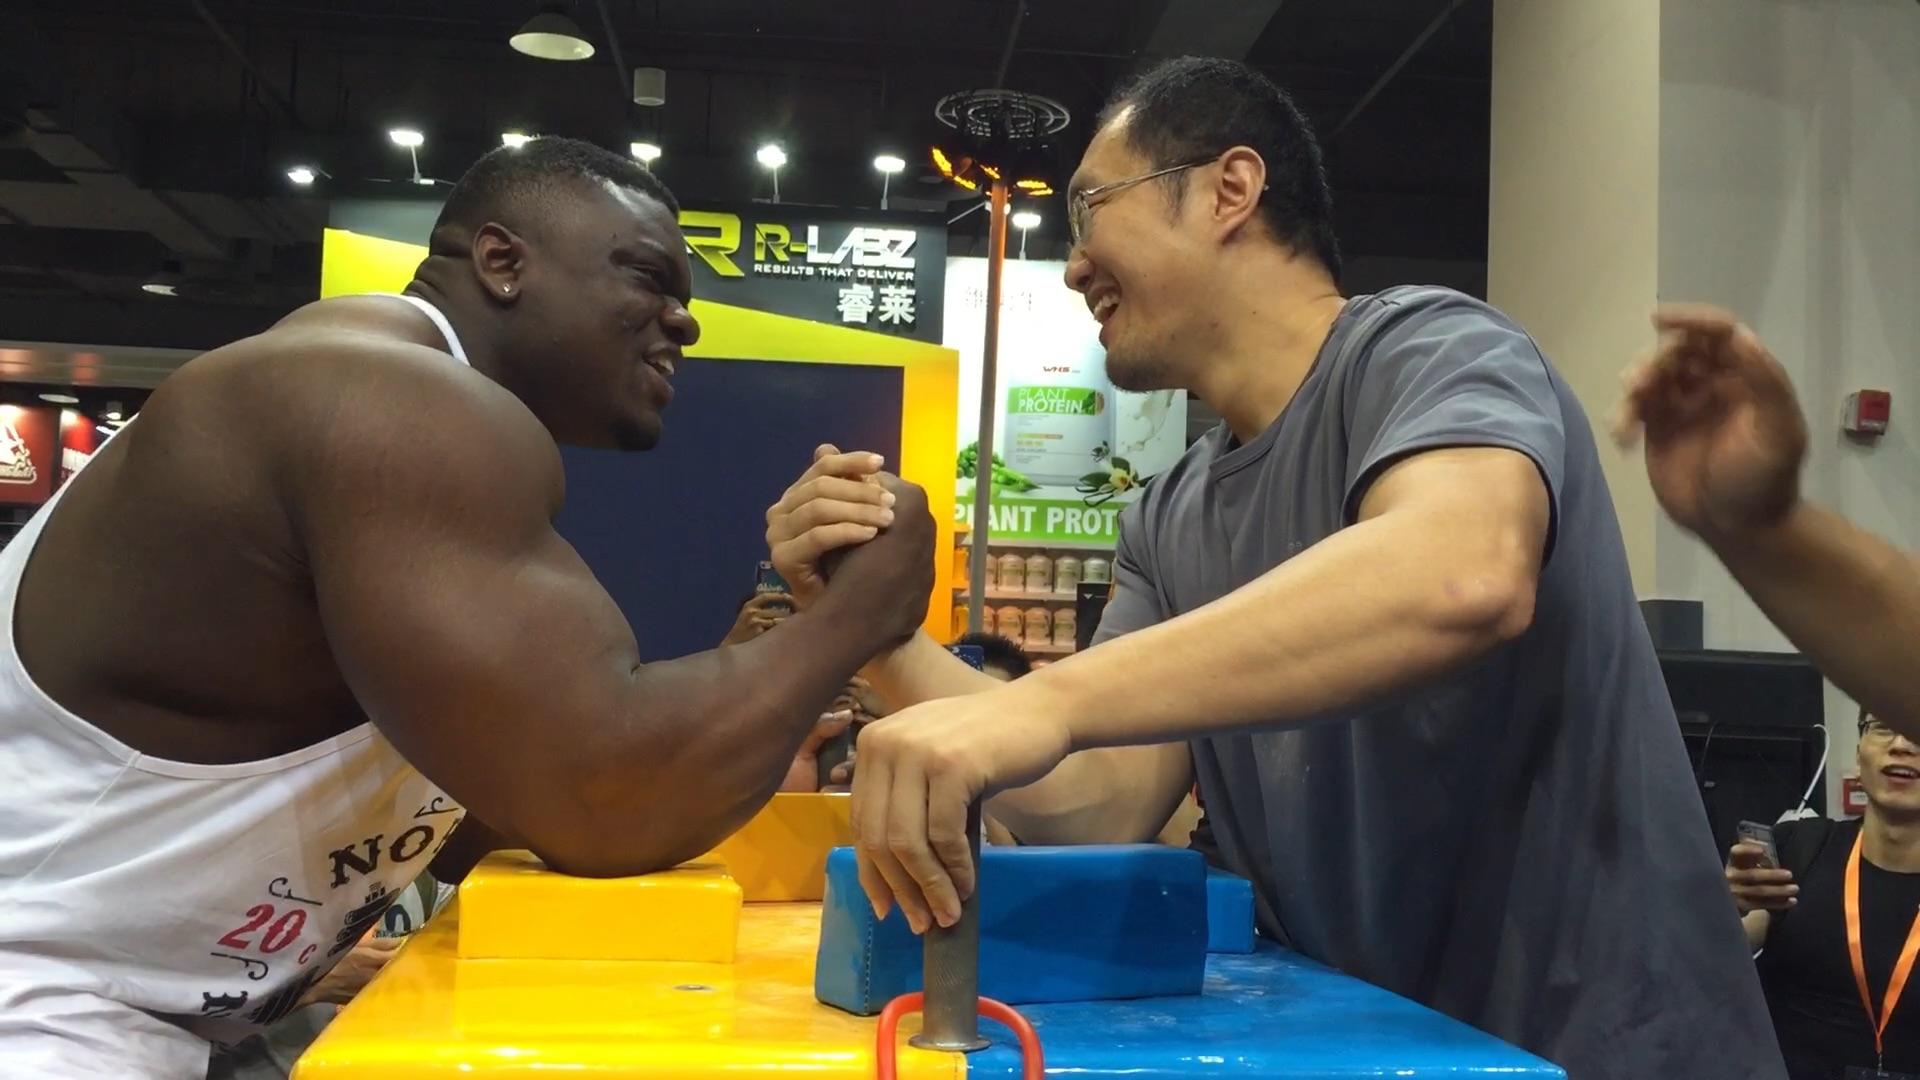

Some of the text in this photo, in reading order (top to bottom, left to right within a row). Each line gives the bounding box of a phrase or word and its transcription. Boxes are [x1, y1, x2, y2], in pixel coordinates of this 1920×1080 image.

[755, 223, 917, 268] R-LABZ
[754, 263, 915, 281] RESULTS THAT DELIVER
[837, 283, 916, 325] 睿莱
[1018, 388, 1070, 401] PLANT
[1018, 400, 1083, 414] PROTEIN
[217, 903, 307, 955] 20
